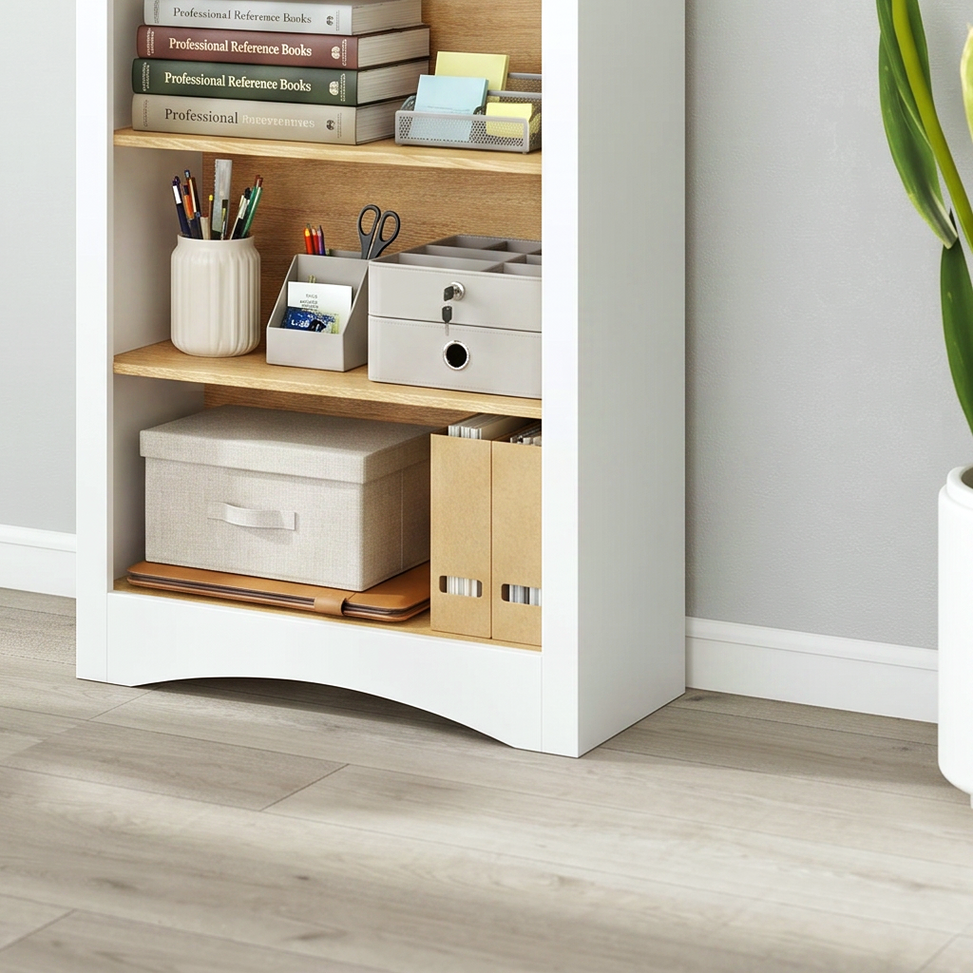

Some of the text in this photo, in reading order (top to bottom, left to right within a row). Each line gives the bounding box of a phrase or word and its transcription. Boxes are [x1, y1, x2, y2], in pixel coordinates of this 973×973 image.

[169, 37, 229, 52] Professional
[231, 41, 280, 55] Reference
[281, 44, 313, 57] Books
[164, 72, 226, 87] Professional
[228, 76, 278, 90] Reference
[279, 79, 312, 92] Books
[165, 108, 239, 124] Professional
